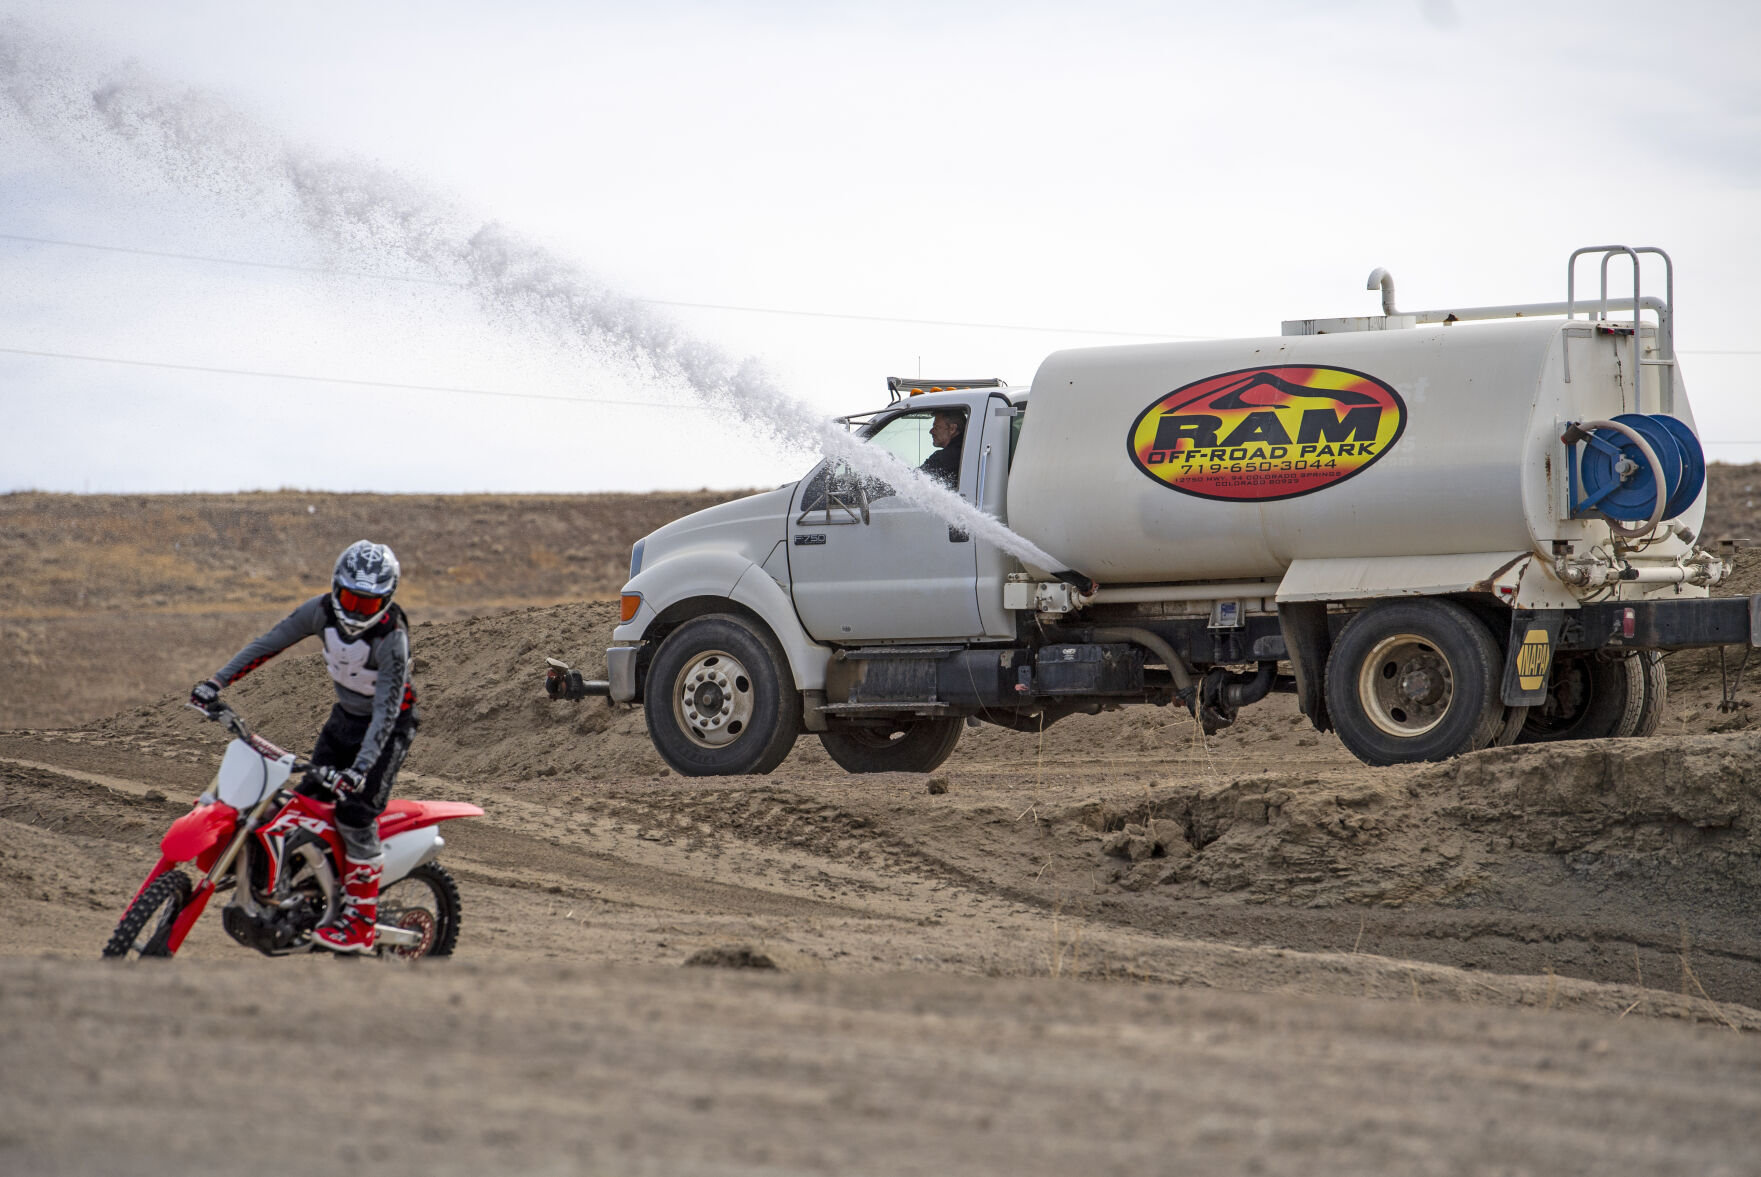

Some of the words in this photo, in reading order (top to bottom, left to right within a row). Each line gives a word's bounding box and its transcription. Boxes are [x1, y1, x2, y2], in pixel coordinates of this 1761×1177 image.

[1152, 407, 1383, 450] RAM
[1147, 447, 1288, 465] OFF-ROAD
[1300, 442, 1377, 458] PARK
[1181, 459, 1337, 475] 719-650-3044
[1215, 479, 1266, 487] COLORADO
[1520, 643, 1549, 676] NAPA
